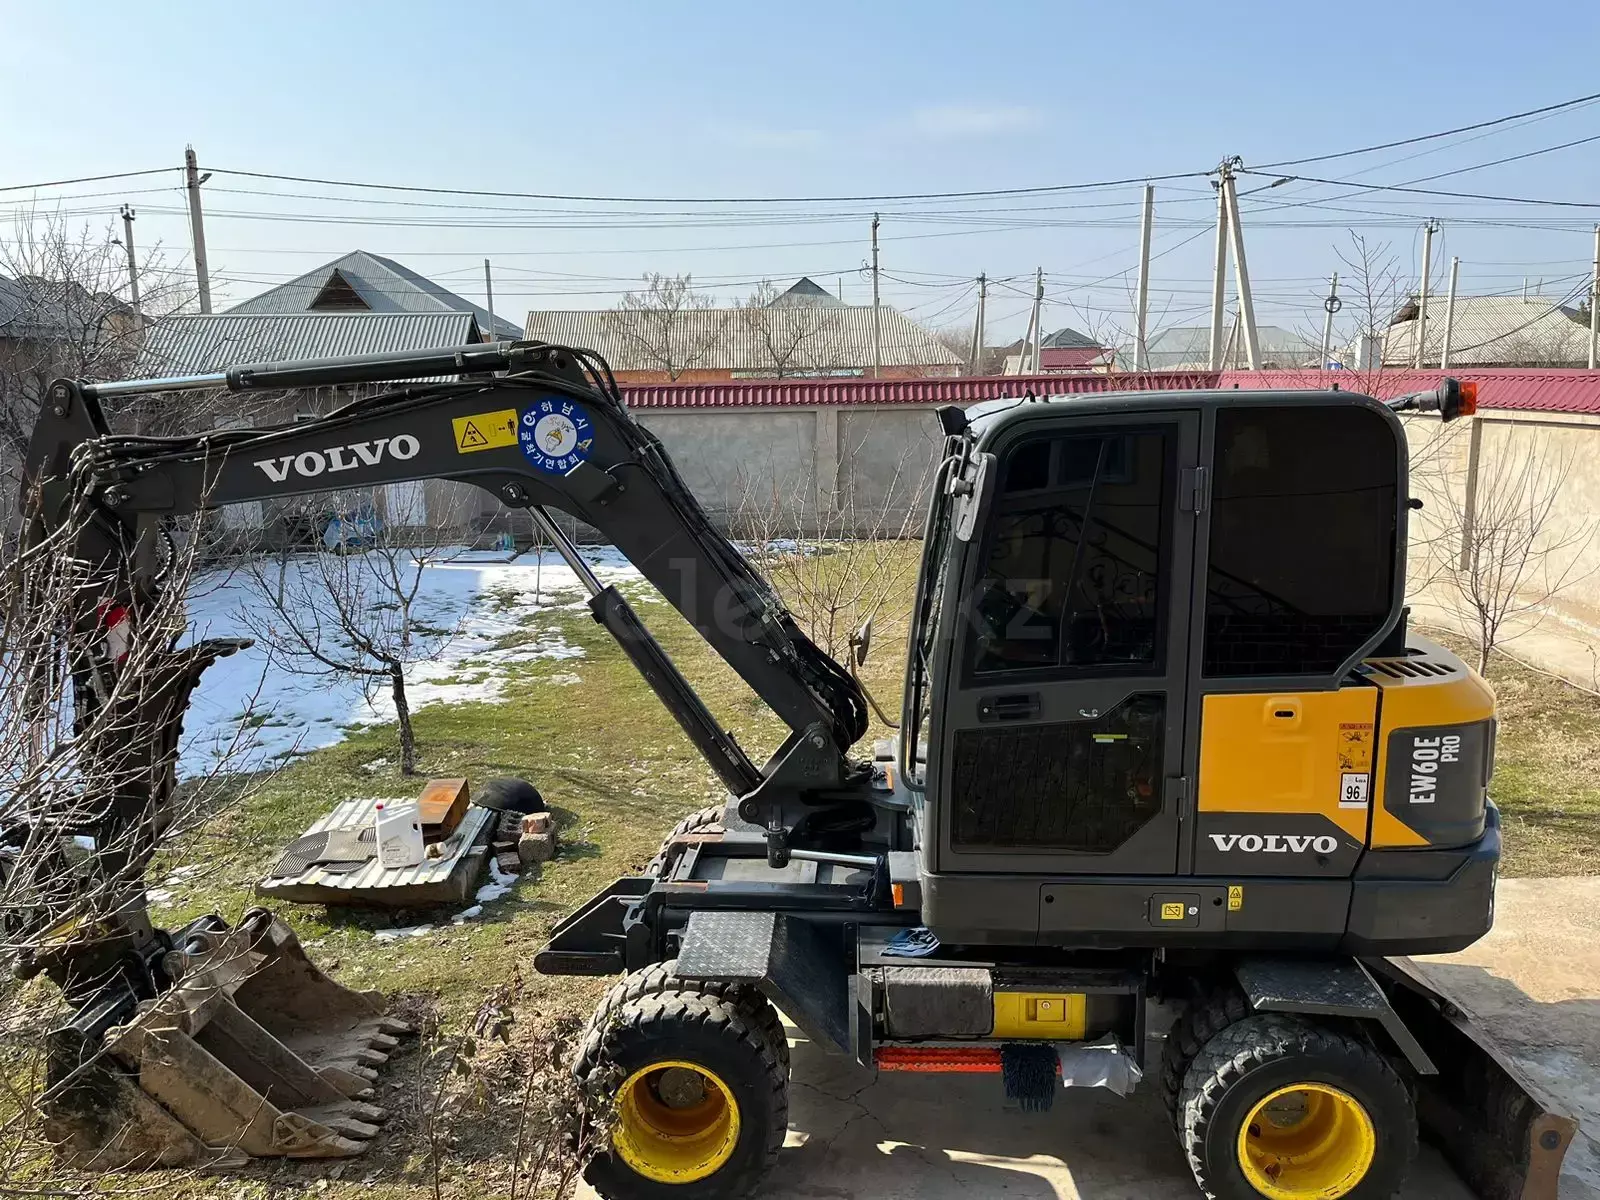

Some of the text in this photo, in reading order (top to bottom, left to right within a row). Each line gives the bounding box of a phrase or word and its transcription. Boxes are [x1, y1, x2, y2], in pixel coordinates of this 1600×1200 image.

[541, 401, 588, 430] 하남시
[254, 434, 420, 482] VOLVO
[1441, 735, 1460, 762] PRO
[1409, 736, 1440, 803] EW60E
[1346, 785, 1360, 800] 96
[1208, 834, 1338, 854] VOLVO
